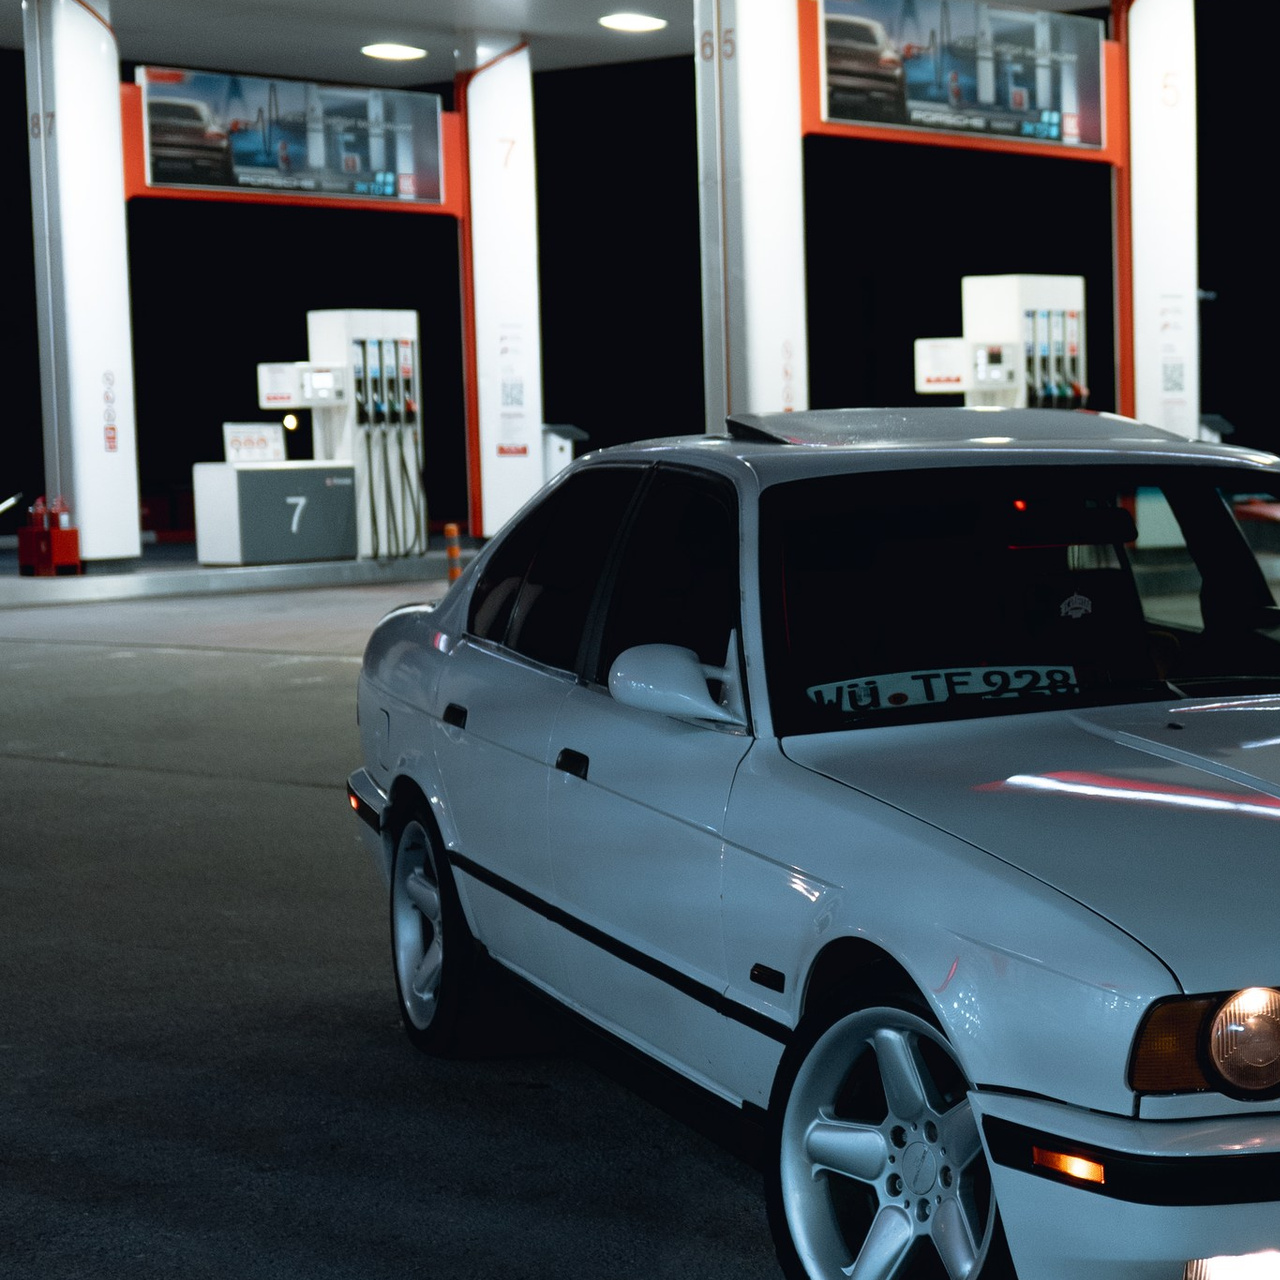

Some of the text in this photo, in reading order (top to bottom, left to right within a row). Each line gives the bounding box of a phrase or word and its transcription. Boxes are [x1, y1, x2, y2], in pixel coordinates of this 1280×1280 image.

[701, 30, 714, 61] 6
[723, 28, 736, 59] 5
[497, 137, 516, 168] 7
[286, 495, 306, 533] 7
[982, 669, 1078, 698] 928
